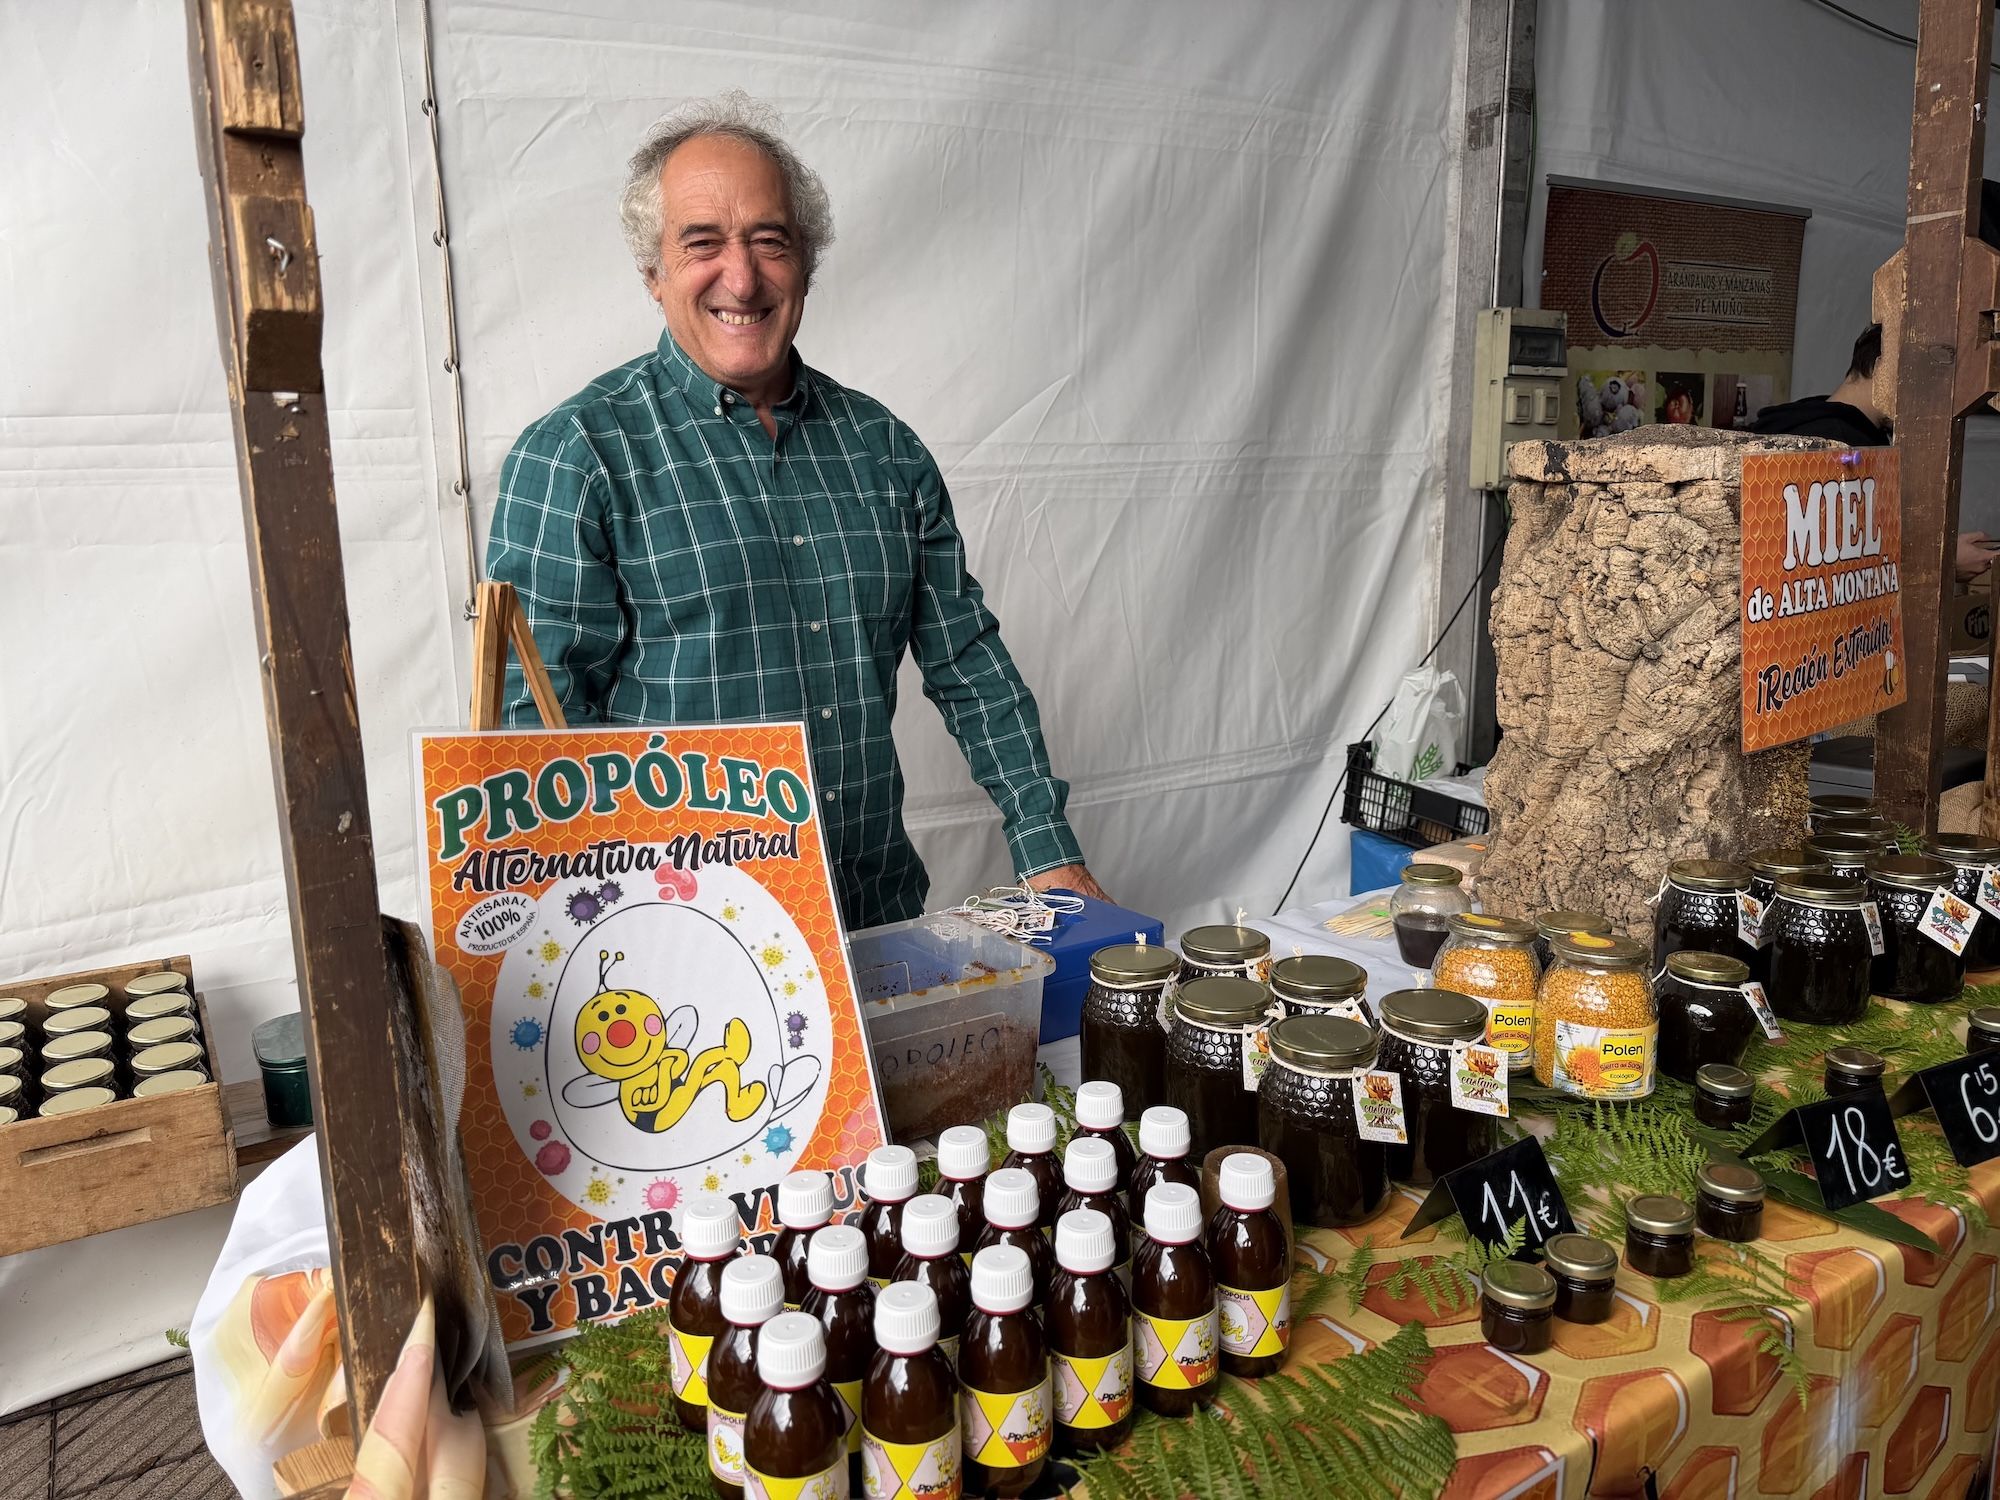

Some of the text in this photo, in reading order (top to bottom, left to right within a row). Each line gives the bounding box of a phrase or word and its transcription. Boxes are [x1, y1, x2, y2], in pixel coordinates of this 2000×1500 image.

[1725, 276, 1771, 294] MANZANAS
[1783, 477, 1882, 571] MIEL
[1747, 555, 1899, 623] de ALTA MONTAÑA
[1756, 614, 1893, 715] ¡Recién Extraída!
[436, 734, 812, 860] PROPÓLEO
[453, 823, 800, 892] Alternativa Natural
[460, 896, 527, 938] ARTESANAL
[468, 911, 536, 952] PRODUCTO DE ESPAÑA
[474, 908, 521, 941] 100%
[1494, 1014, 1531, 1026] Polen
[1602, 1044, 1643, 1056] Polen
[1461, 1076, 1499, 1090] castaño
[1364, 1103, 1397, 1115] castaño
[489, 1211, 683, 1289] CONTR
[516, 1284, 559, 1331] Y
[1197, 1367, 1215, 1383] MIEL
[1026, 1440, 1048, 1460] MIEL
